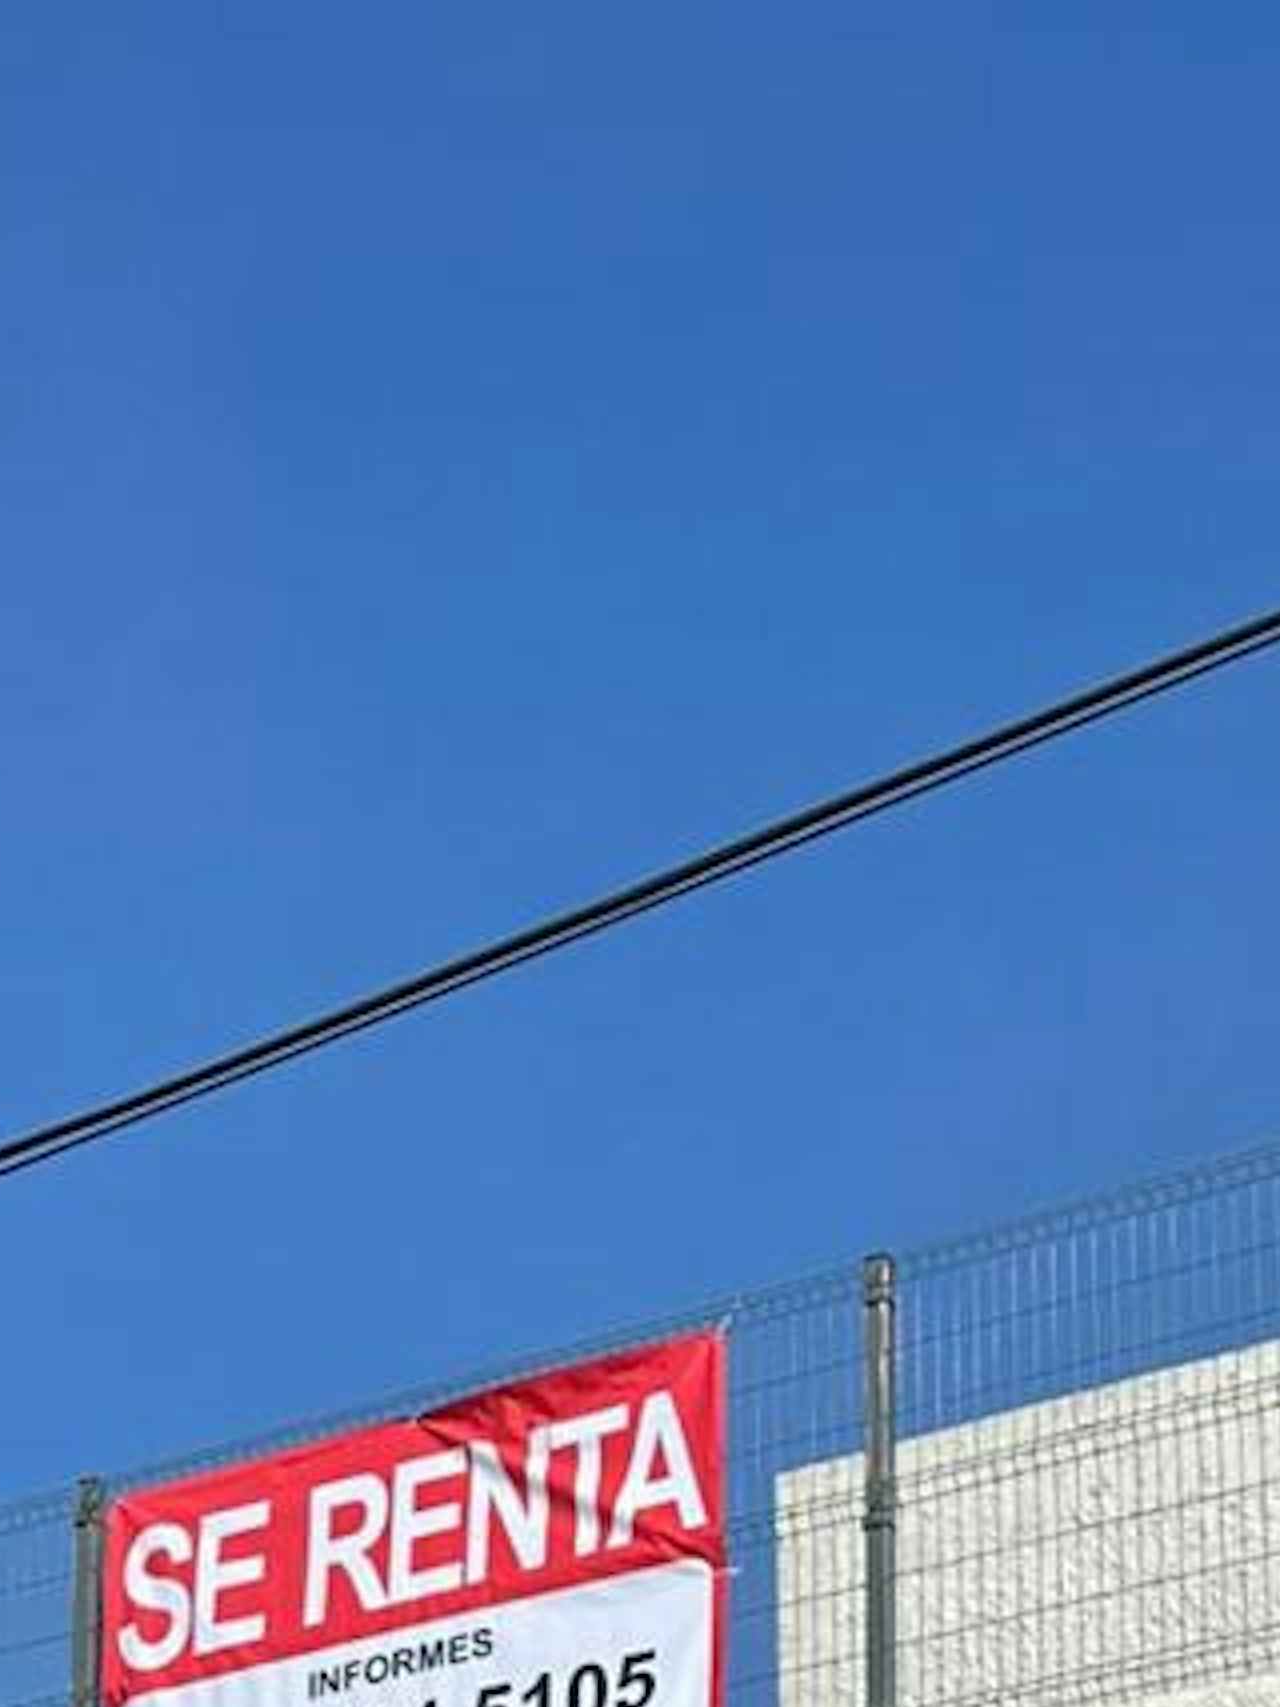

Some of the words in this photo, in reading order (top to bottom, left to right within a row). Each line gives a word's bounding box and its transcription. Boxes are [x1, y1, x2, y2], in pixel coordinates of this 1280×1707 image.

[118, 1500, 269, 1672] SE
[304, 1390, 708, 1629] RENTA
[307, 1628, 494, 1698] INFORMES
